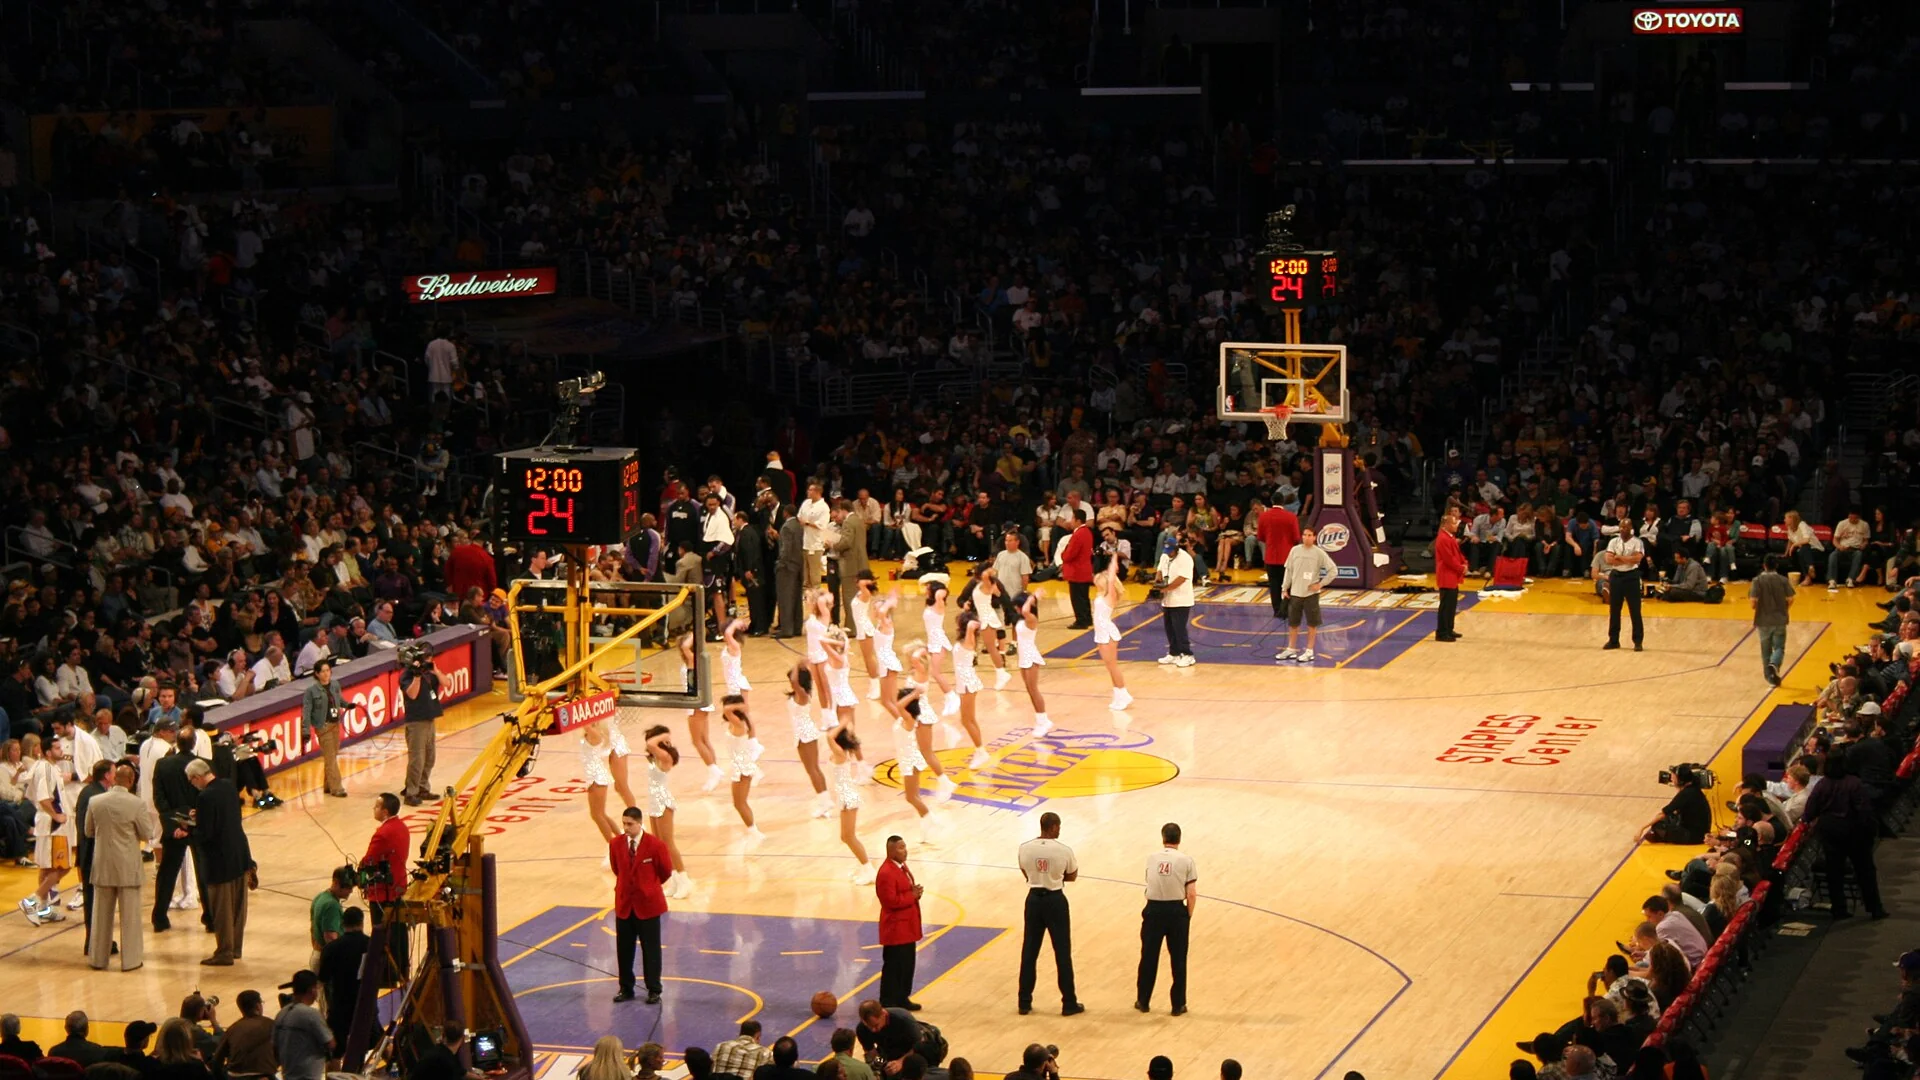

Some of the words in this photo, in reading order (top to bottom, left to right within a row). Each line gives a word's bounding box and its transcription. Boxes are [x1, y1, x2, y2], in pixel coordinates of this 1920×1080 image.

[1664, 13, 1740, 28] TOYOTA
[1271, 259, 1308, 275] 12:00
[417, 273, 538, 300] Budweiser
[1271, 276, 1303, 301] 24
[526, 468, 582, 492] 12:00
[528, 494, 574, 535] 24
[1321, 530, 1347, 545] Lite
[572, 697, 614, 724] AAA.com
[243, 685, 386, 772] nsuce
[1435, 714, 1542, 764] STAPLES
[1502, 716, 1603, 766] Center
[1159, 862, 1170, 875] 24
